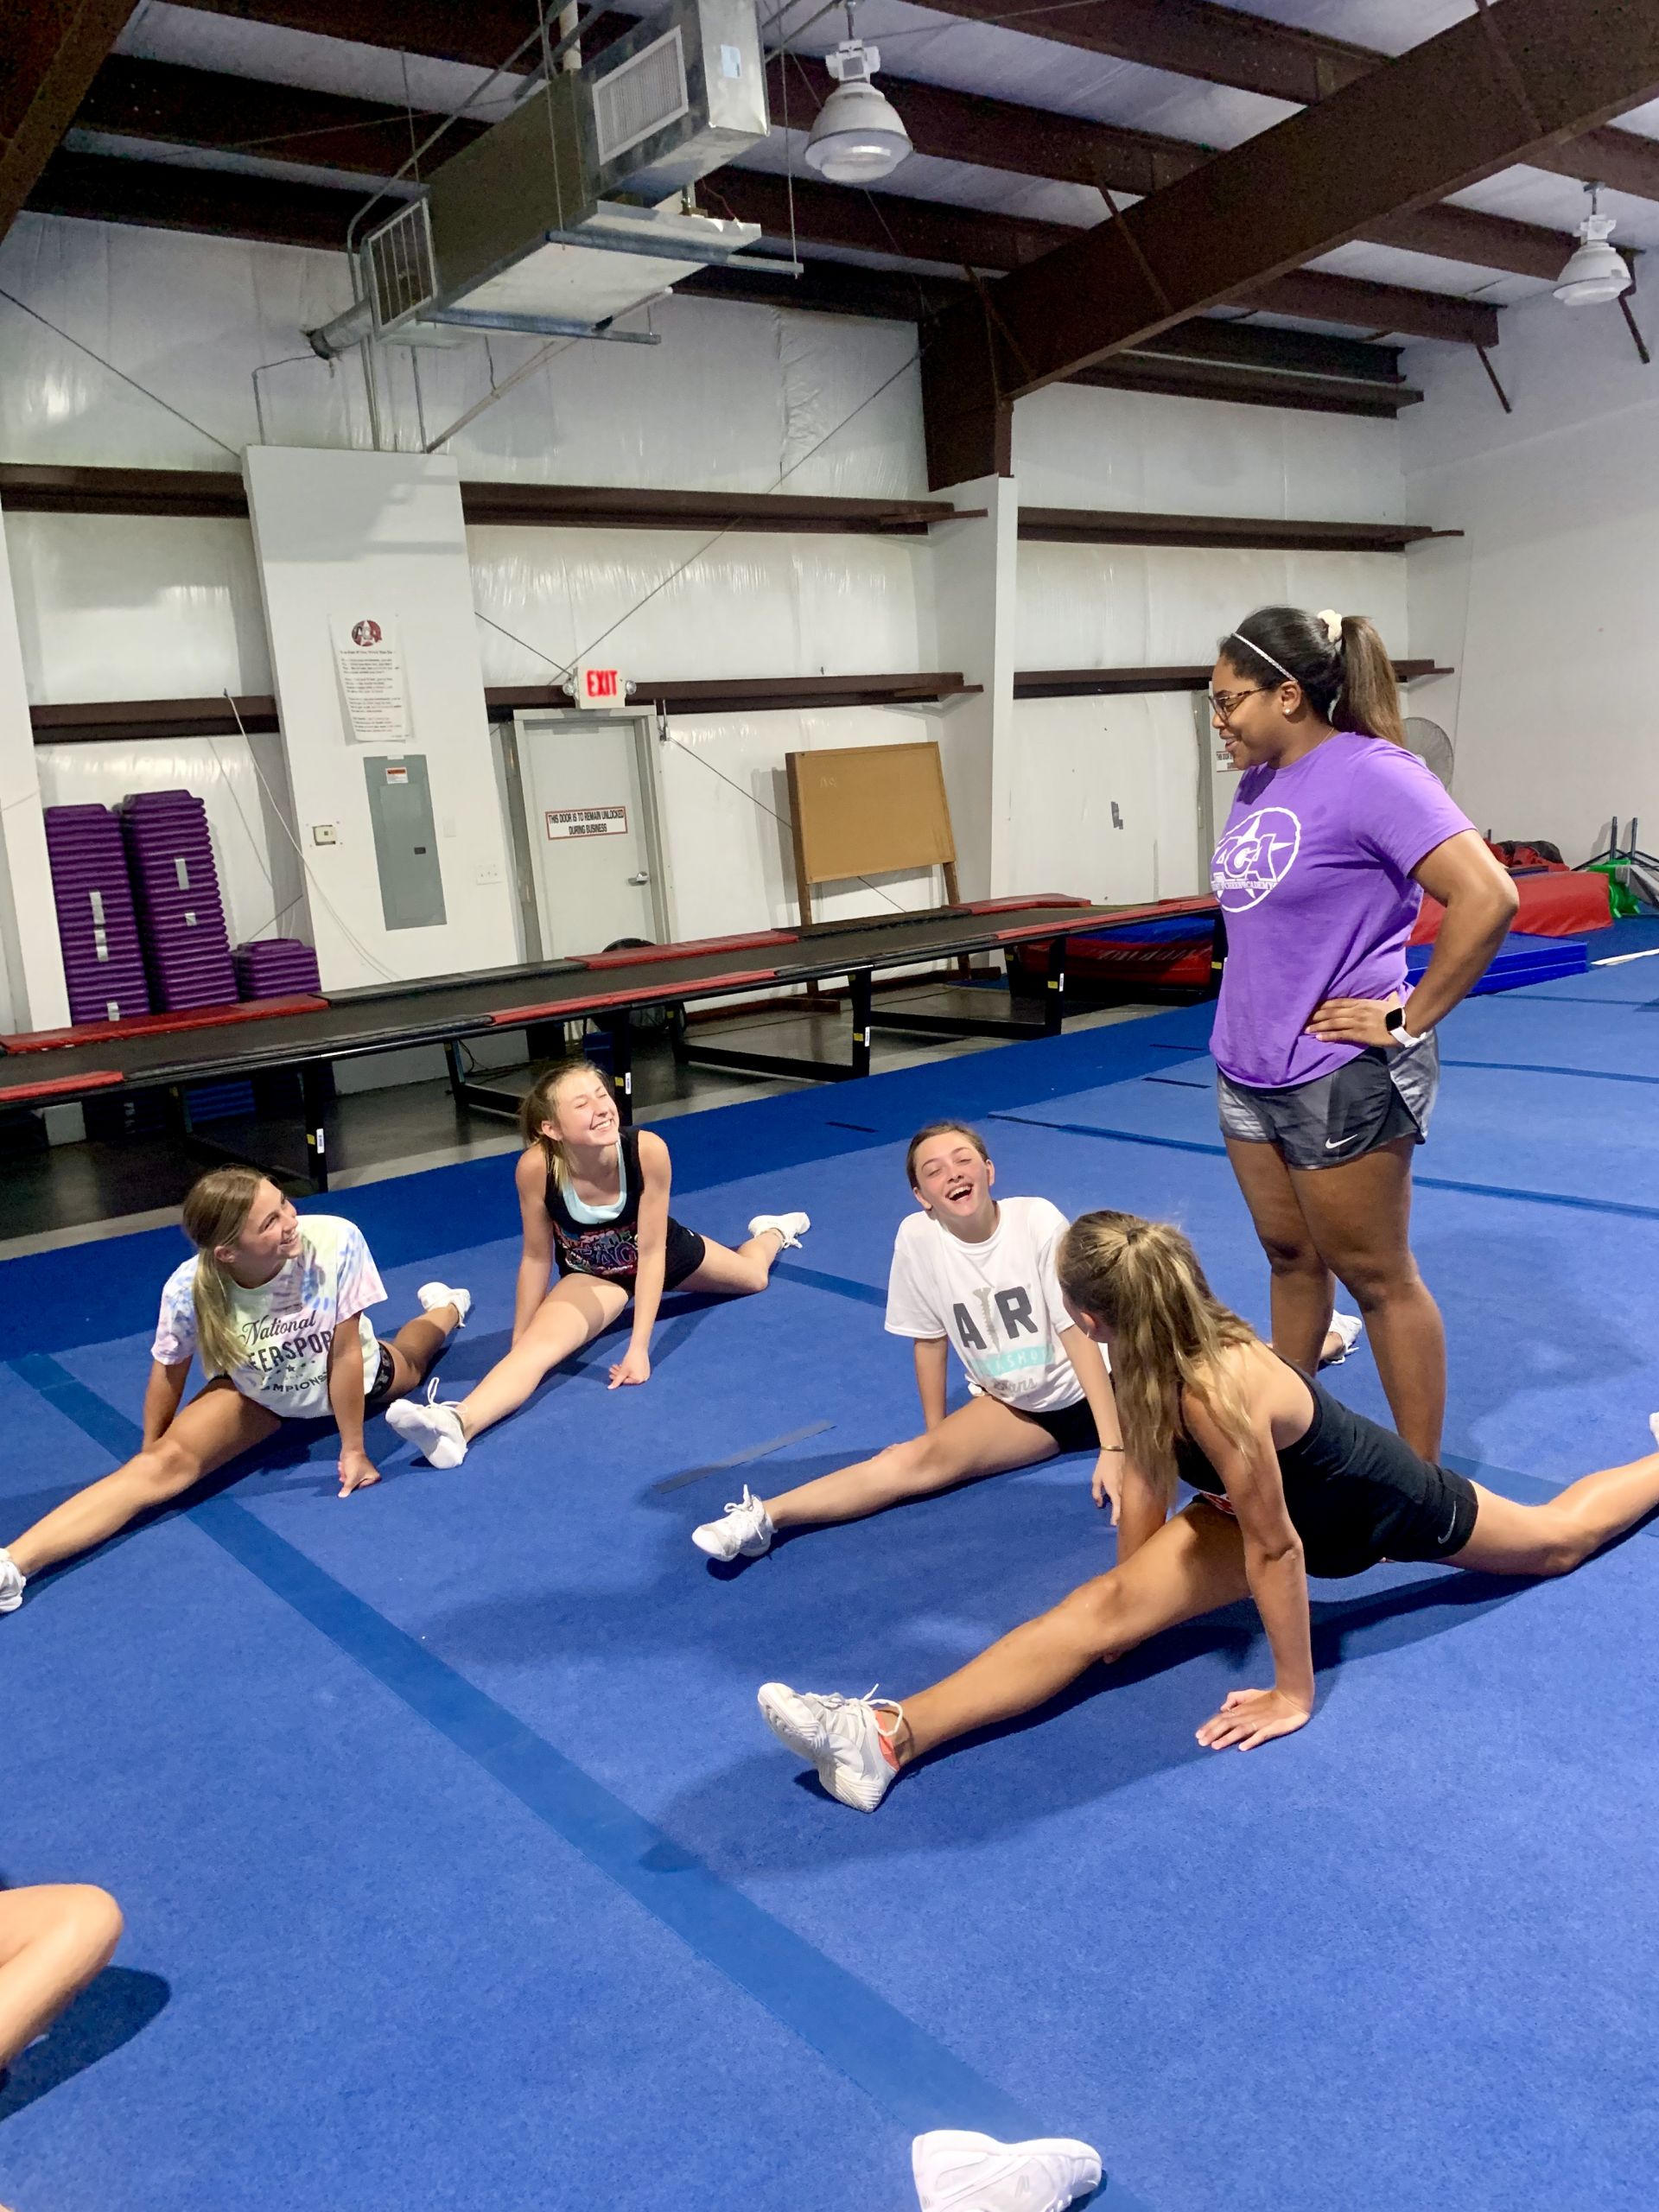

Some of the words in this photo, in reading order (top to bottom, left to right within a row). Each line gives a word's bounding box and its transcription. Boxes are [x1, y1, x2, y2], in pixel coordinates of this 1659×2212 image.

[587, 670, 618, 697] EXIT
[548, 815, 559, 823] THIS
[560, 813, 572, 823] DOOR
[573, 813, 577, 822] IS
[578, 812, 584, 821] TO
[584, 810, 601, 821] REMAIN
[601, 810, 625, 820] UNLOCKED
[569, 824, 586, 836] DURING
[586, 823, 607, 834] BUSINESS
[238, 1310, 317, 1346] National
[248, 1331, 332, 1372] EERSPOR
[262, 1371, 327, 1392] MPIONS
